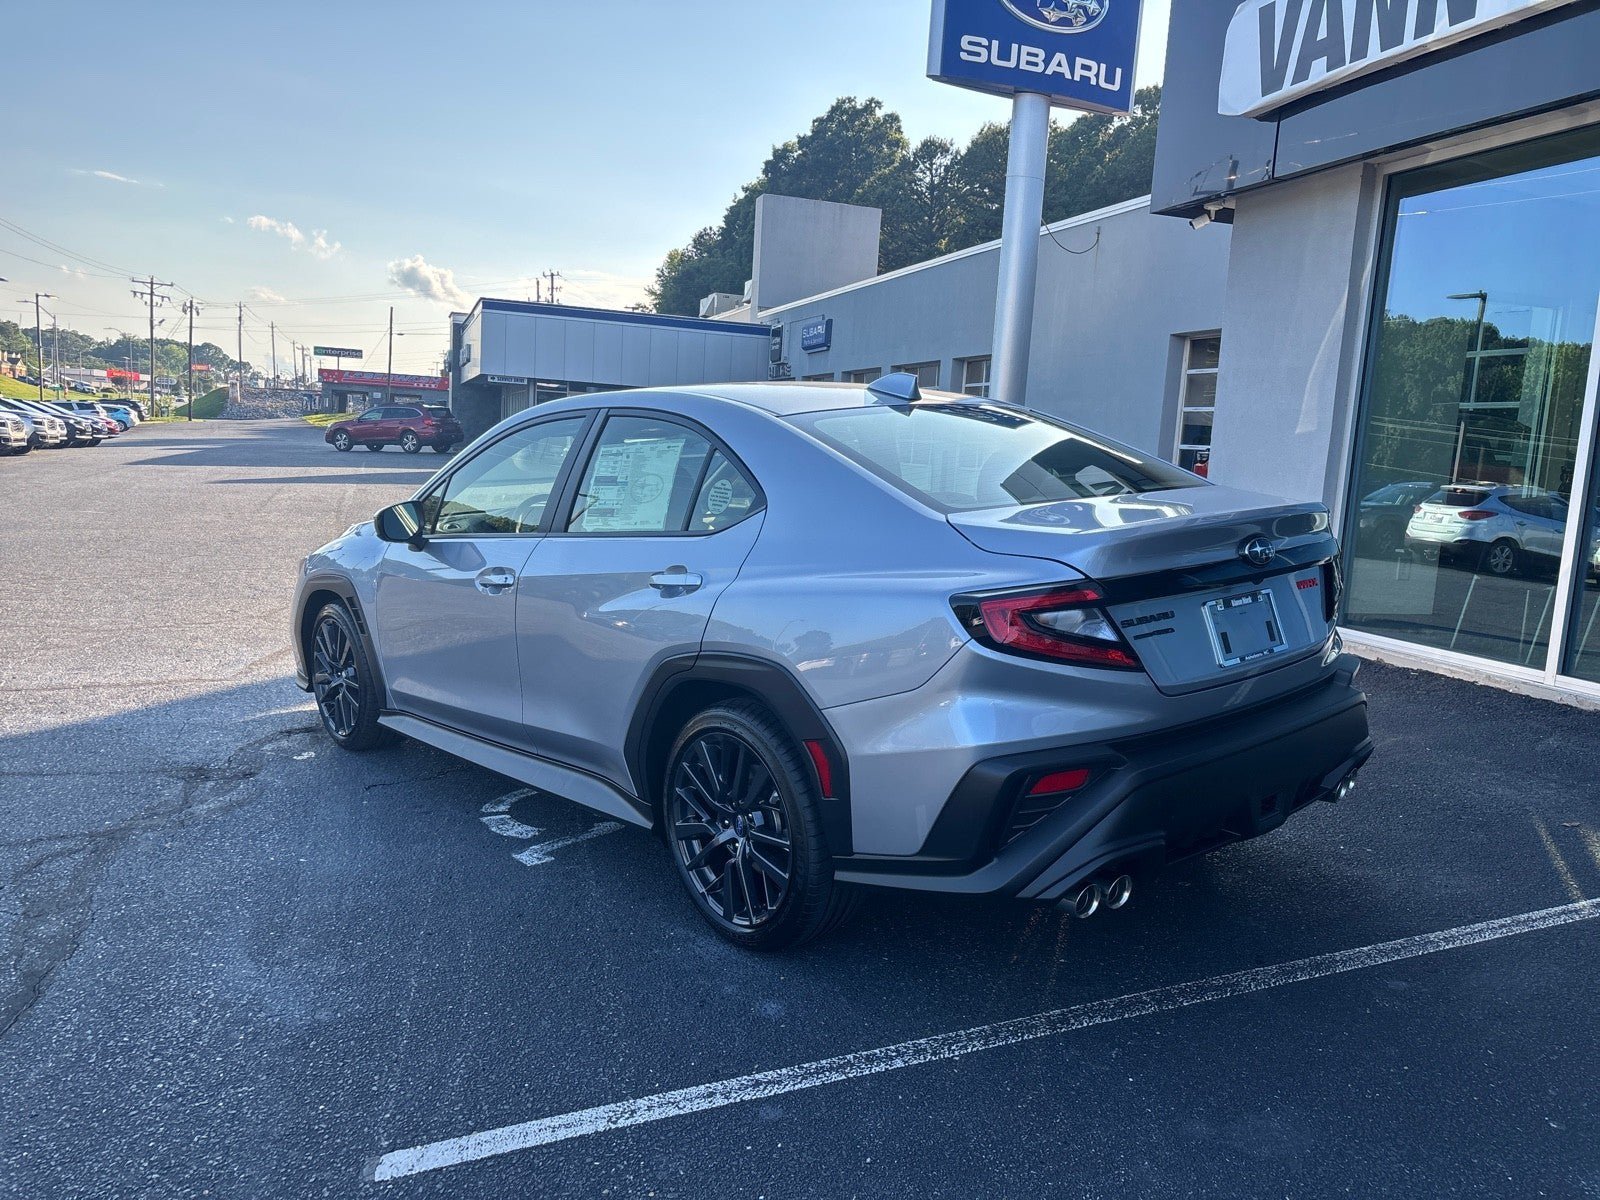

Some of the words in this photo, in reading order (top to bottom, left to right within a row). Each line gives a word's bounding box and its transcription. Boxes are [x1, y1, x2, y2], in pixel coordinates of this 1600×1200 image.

[959, 34, 1122, 92] SUBARU
[803, 325, 825, 338] SUBARU
[316, 348, 362, 357] enterprise
[1297, 578, 1319, 590] WRX
[1121, 611, 1175, 628] SUBARU
